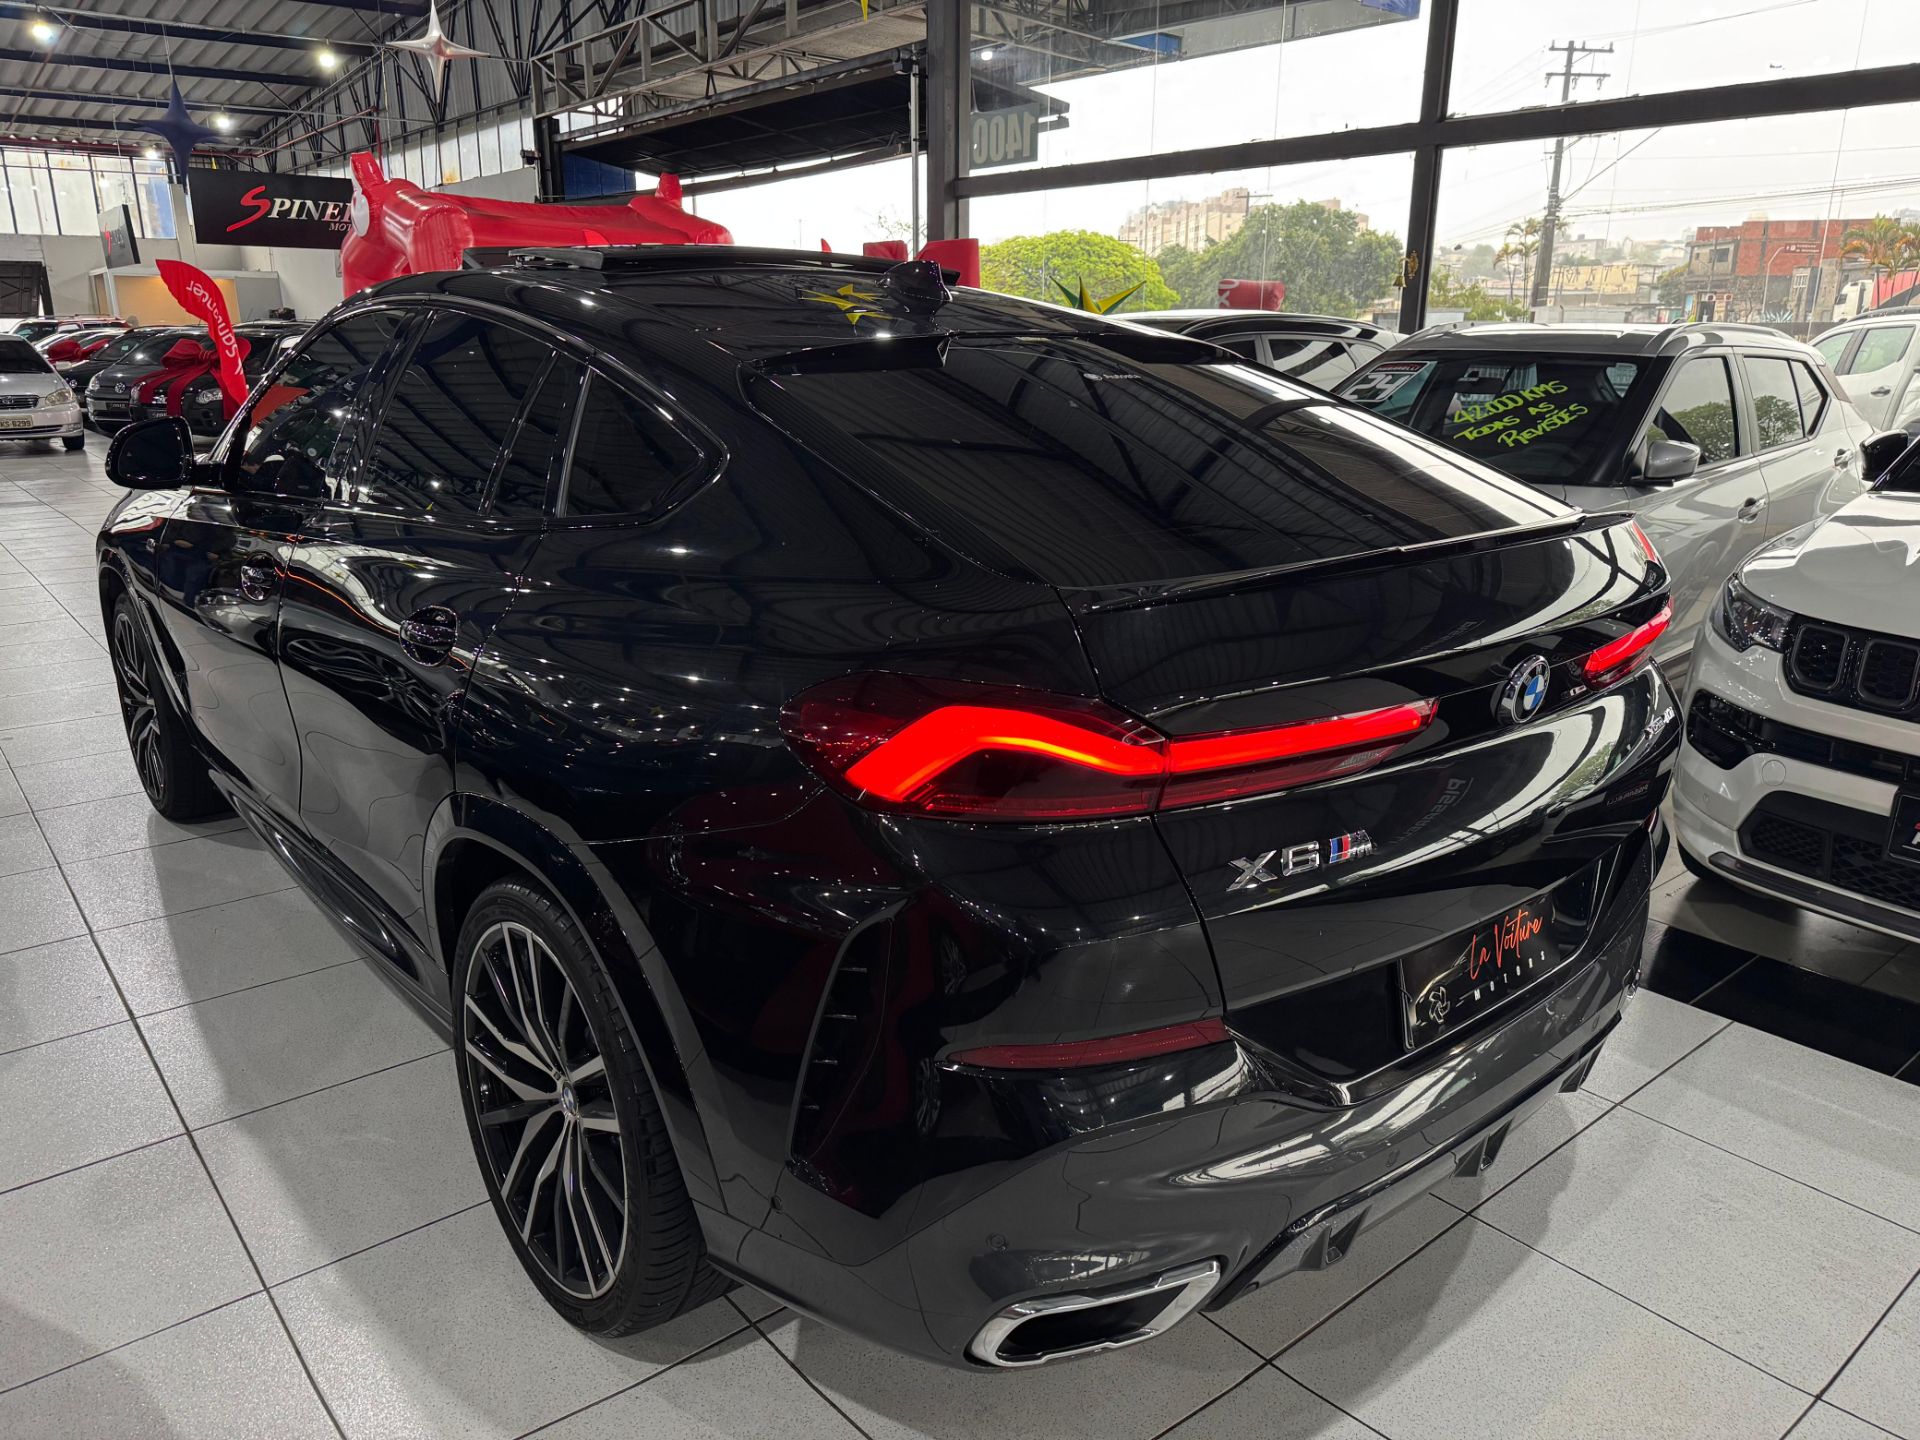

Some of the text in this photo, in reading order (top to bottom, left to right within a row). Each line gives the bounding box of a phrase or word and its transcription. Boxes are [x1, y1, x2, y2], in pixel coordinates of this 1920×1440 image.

[1341, 373, 1411, 400] 24
[1519, 380, 1568, 401] KMS
[1528, 401, 1555, 415] AS
[1226, 841, 1320, 892] X6
[1494, 909, 1543, 969] Voiture
[1474, 950, 1545, 1000] MOTORS
